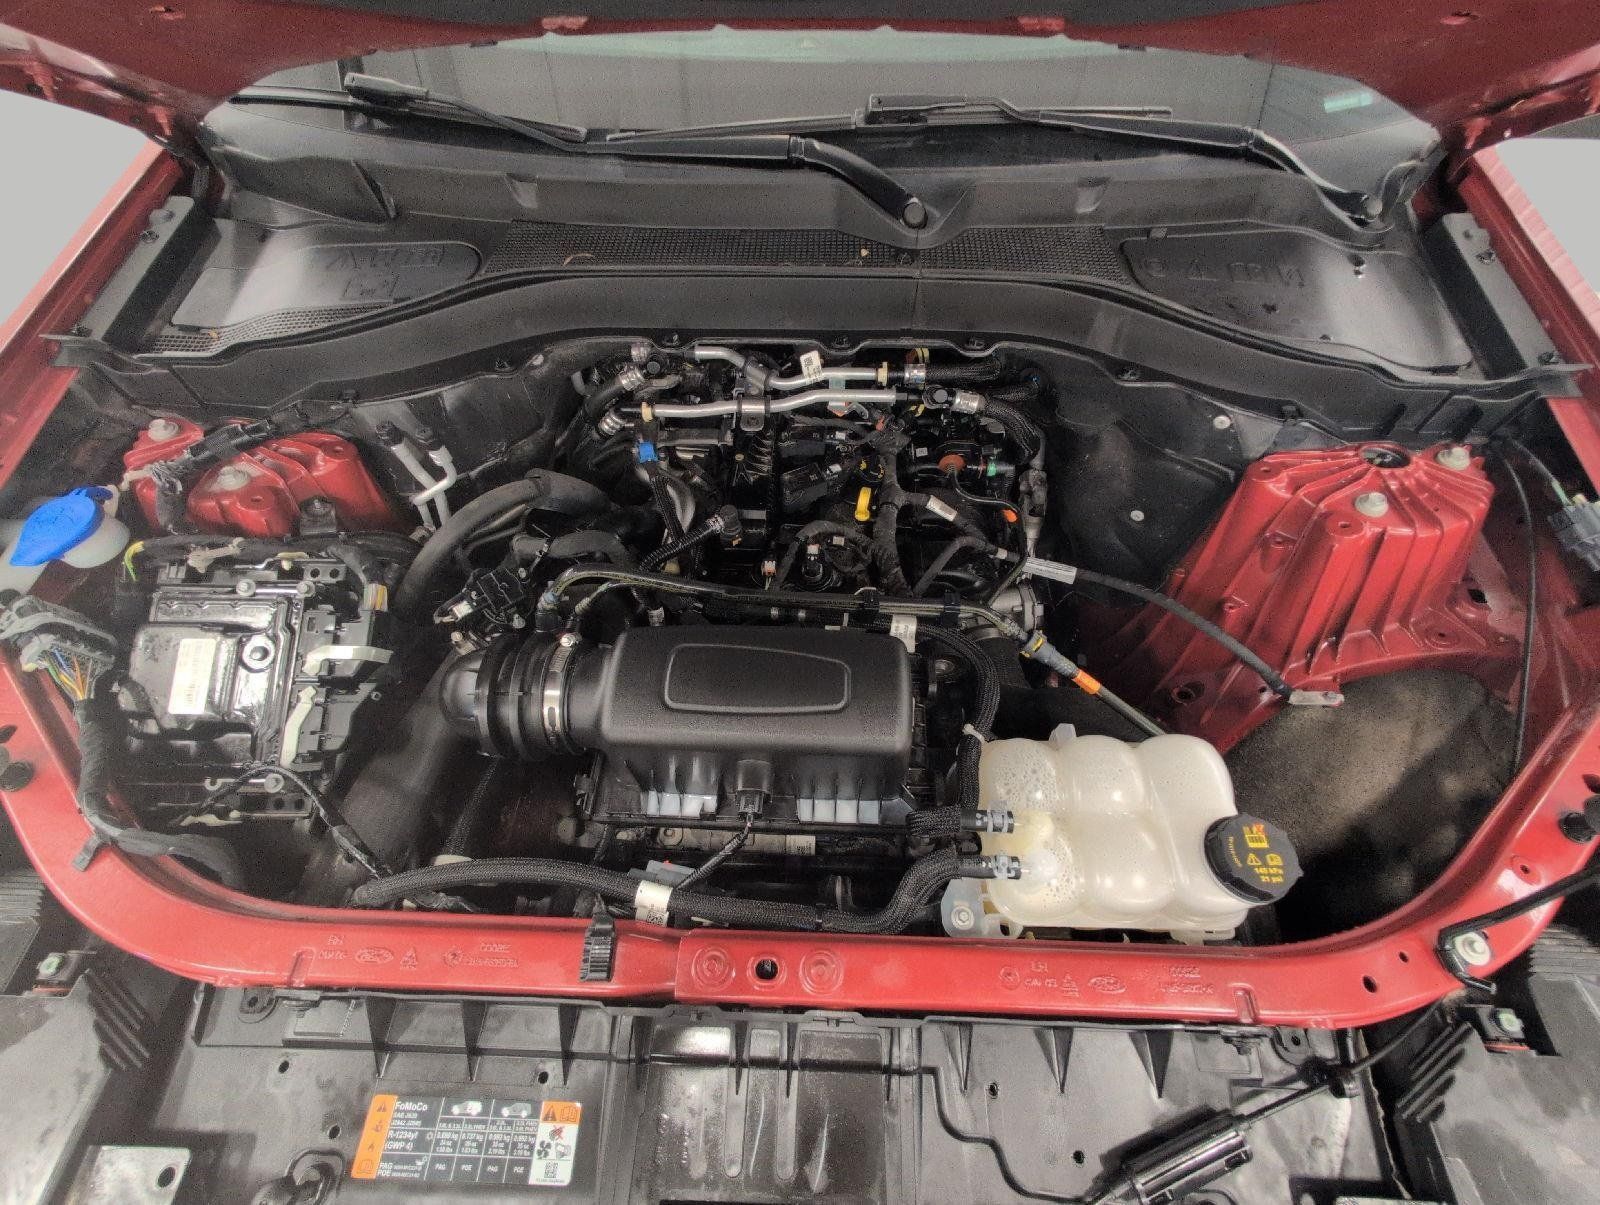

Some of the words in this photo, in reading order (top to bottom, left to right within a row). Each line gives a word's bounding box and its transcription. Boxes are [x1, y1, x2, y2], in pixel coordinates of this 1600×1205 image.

[395, 1101, 428, 1111] FoMoCo
[388, 1130, 419, 1140] R-1234yf
[384, 1141, 405, 1151] (GWP
[406, 1142, 414, 1151] 4)
[379, 1162, 393, 1170] PAG
[435, 1163, 446, 1171] PAG
